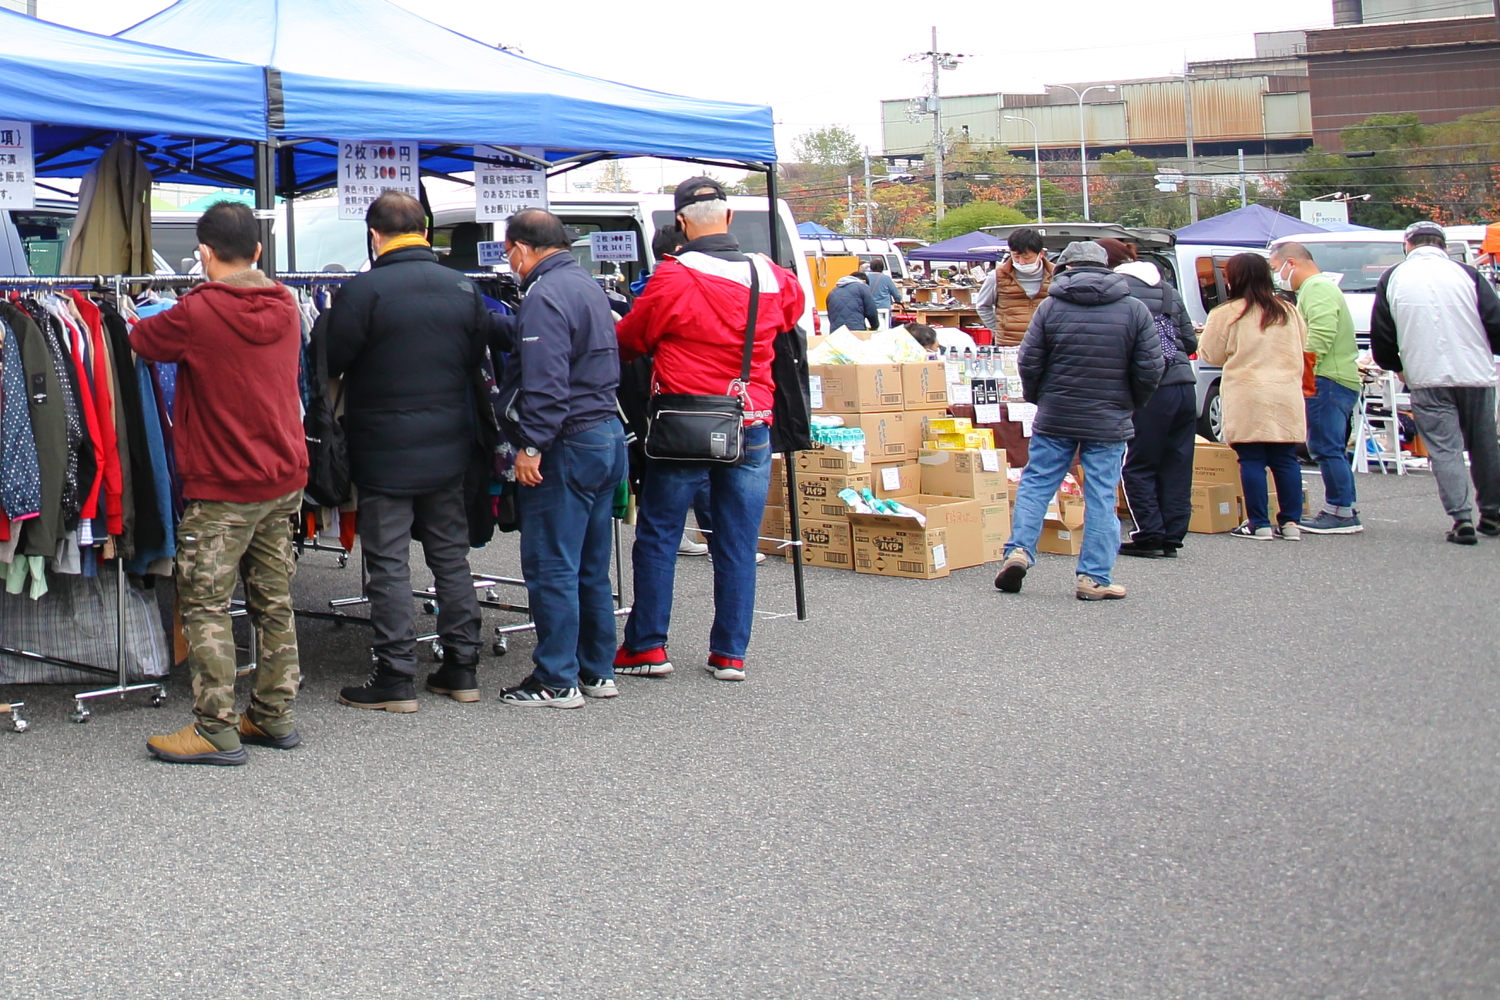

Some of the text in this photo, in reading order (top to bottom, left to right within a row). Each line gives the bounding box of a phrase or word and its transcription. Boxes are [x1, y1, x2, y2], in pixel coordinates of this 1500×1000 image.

[482, 189, 540, 199] のある方には販売
[741, 409, 773, 420] EAD
